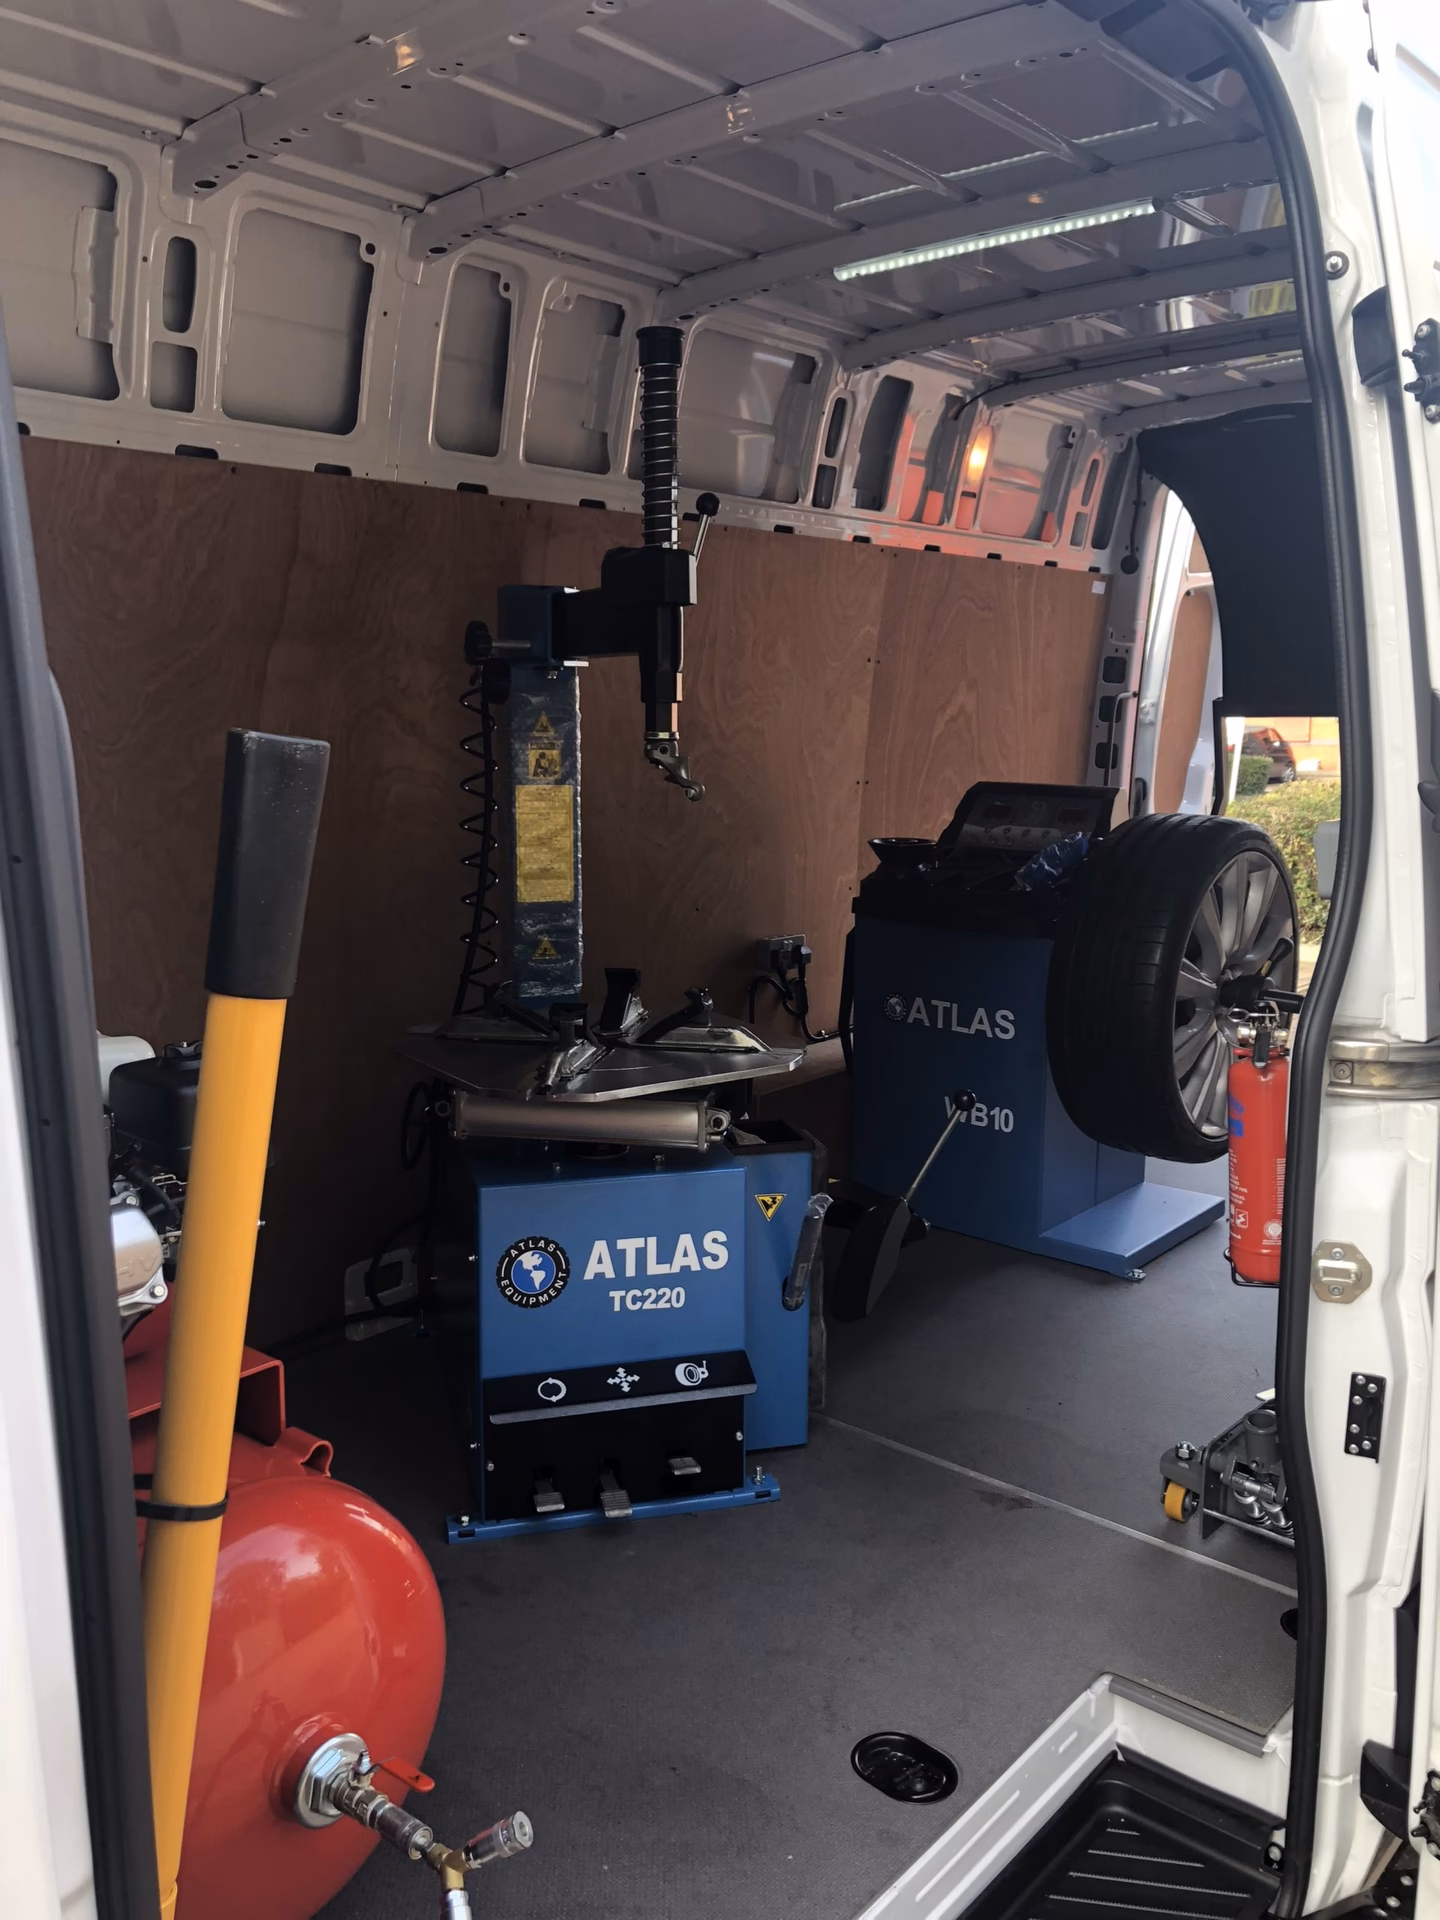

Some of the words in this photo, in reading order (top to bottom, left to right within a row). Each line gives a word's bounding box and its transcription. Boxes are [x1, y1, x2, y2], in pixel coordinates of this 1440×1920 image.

[907, 997, 1015, 1040] ATLAS
[510, 1239, 556, 1258] ATLAS
[583, 1231, 729, 1280] ATLAS
[501, 1271, 567, 1305] EQUIPMENT
[609, 1286, 686, 1312] TC220
